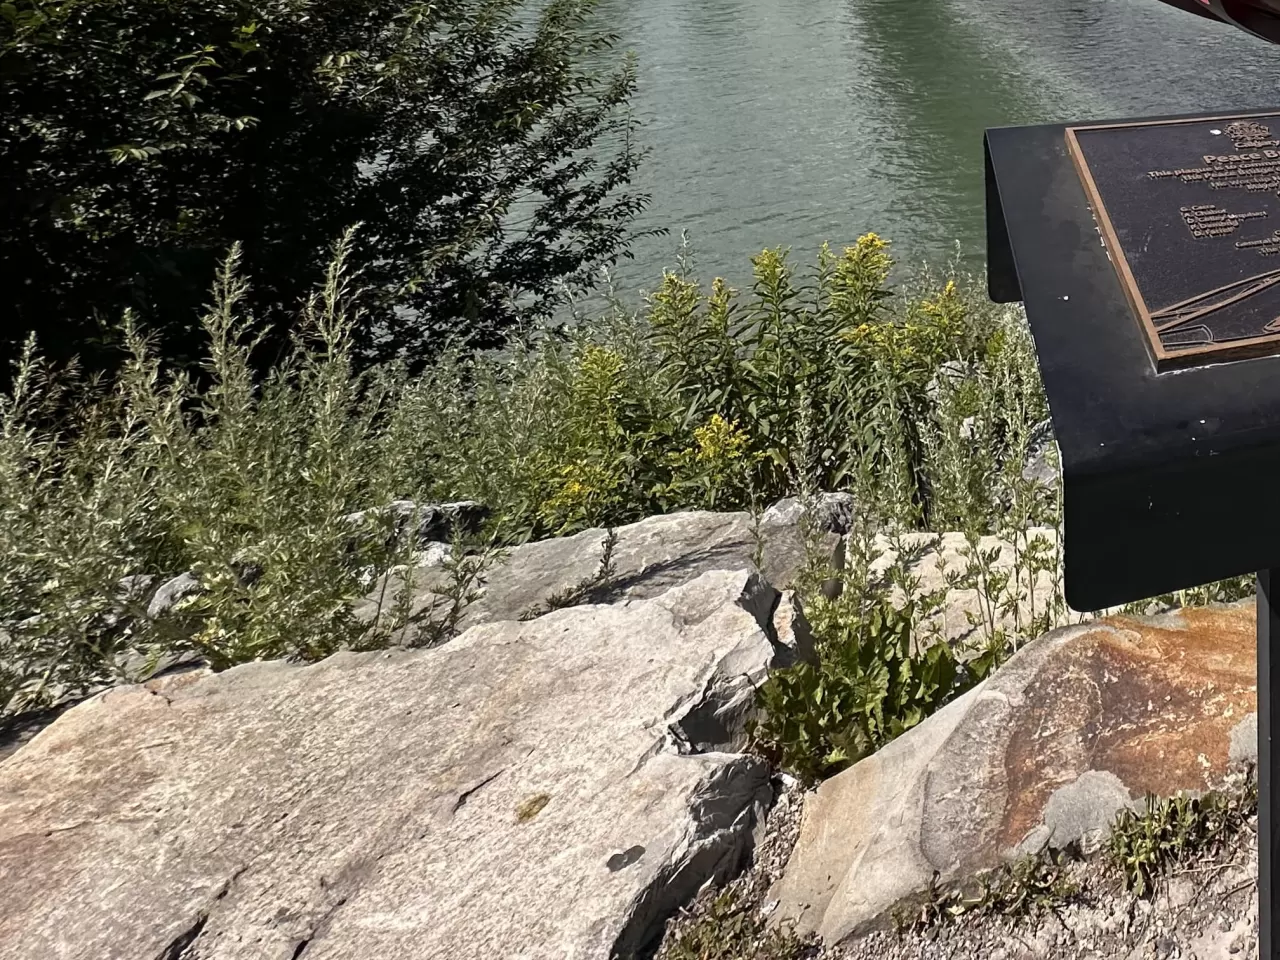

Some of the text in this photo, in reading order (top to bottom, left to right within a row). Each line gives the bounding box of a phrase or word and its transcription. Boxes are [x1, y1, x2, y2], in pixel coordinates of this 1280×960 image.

[1234, 140, 1280, 149] Calgary
[1203, 152, 1261, 163] Peace
[1230, 178, 1270, 186] Worship
